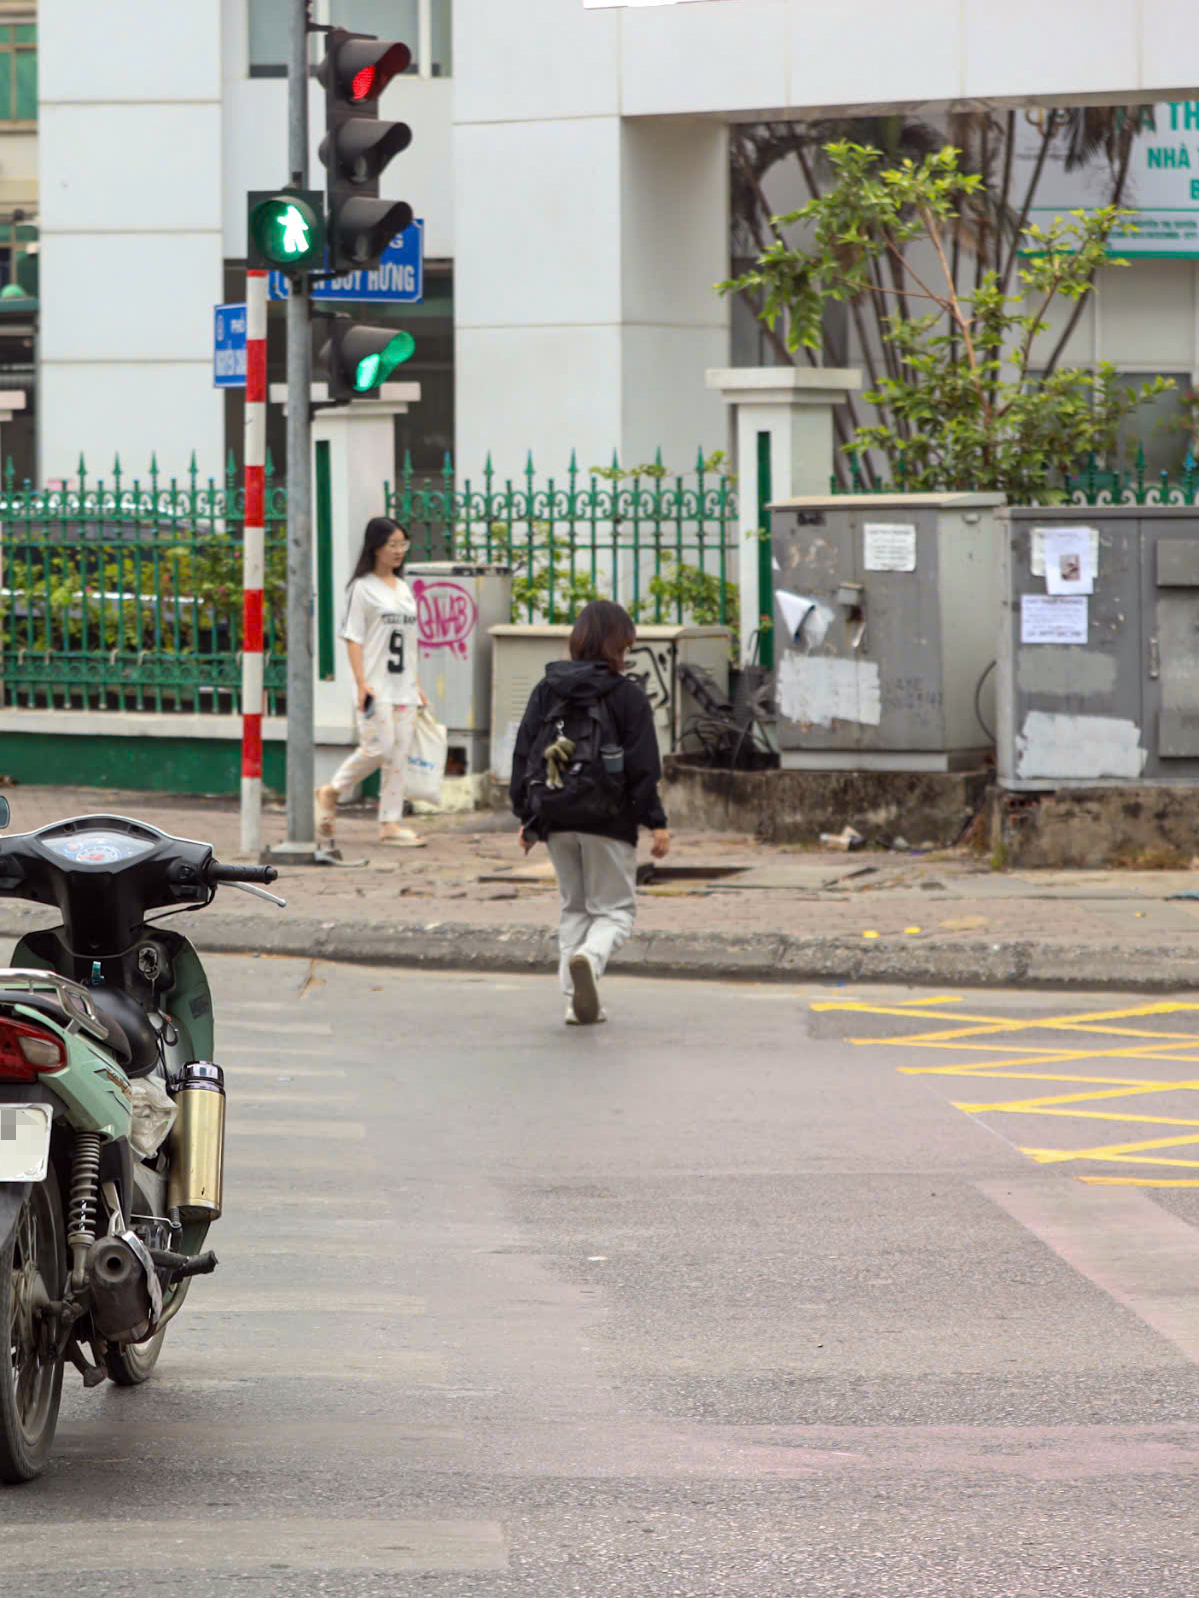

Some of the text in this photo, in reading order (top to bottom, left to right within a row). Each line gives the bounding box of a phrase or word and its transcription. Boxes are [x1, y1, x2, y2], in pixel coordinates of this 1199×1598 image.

[1147, 143, 1191, 169] NHÀ
[368, 263, 415, 292] HƯNG
[387, 629, 405, 674] 9
